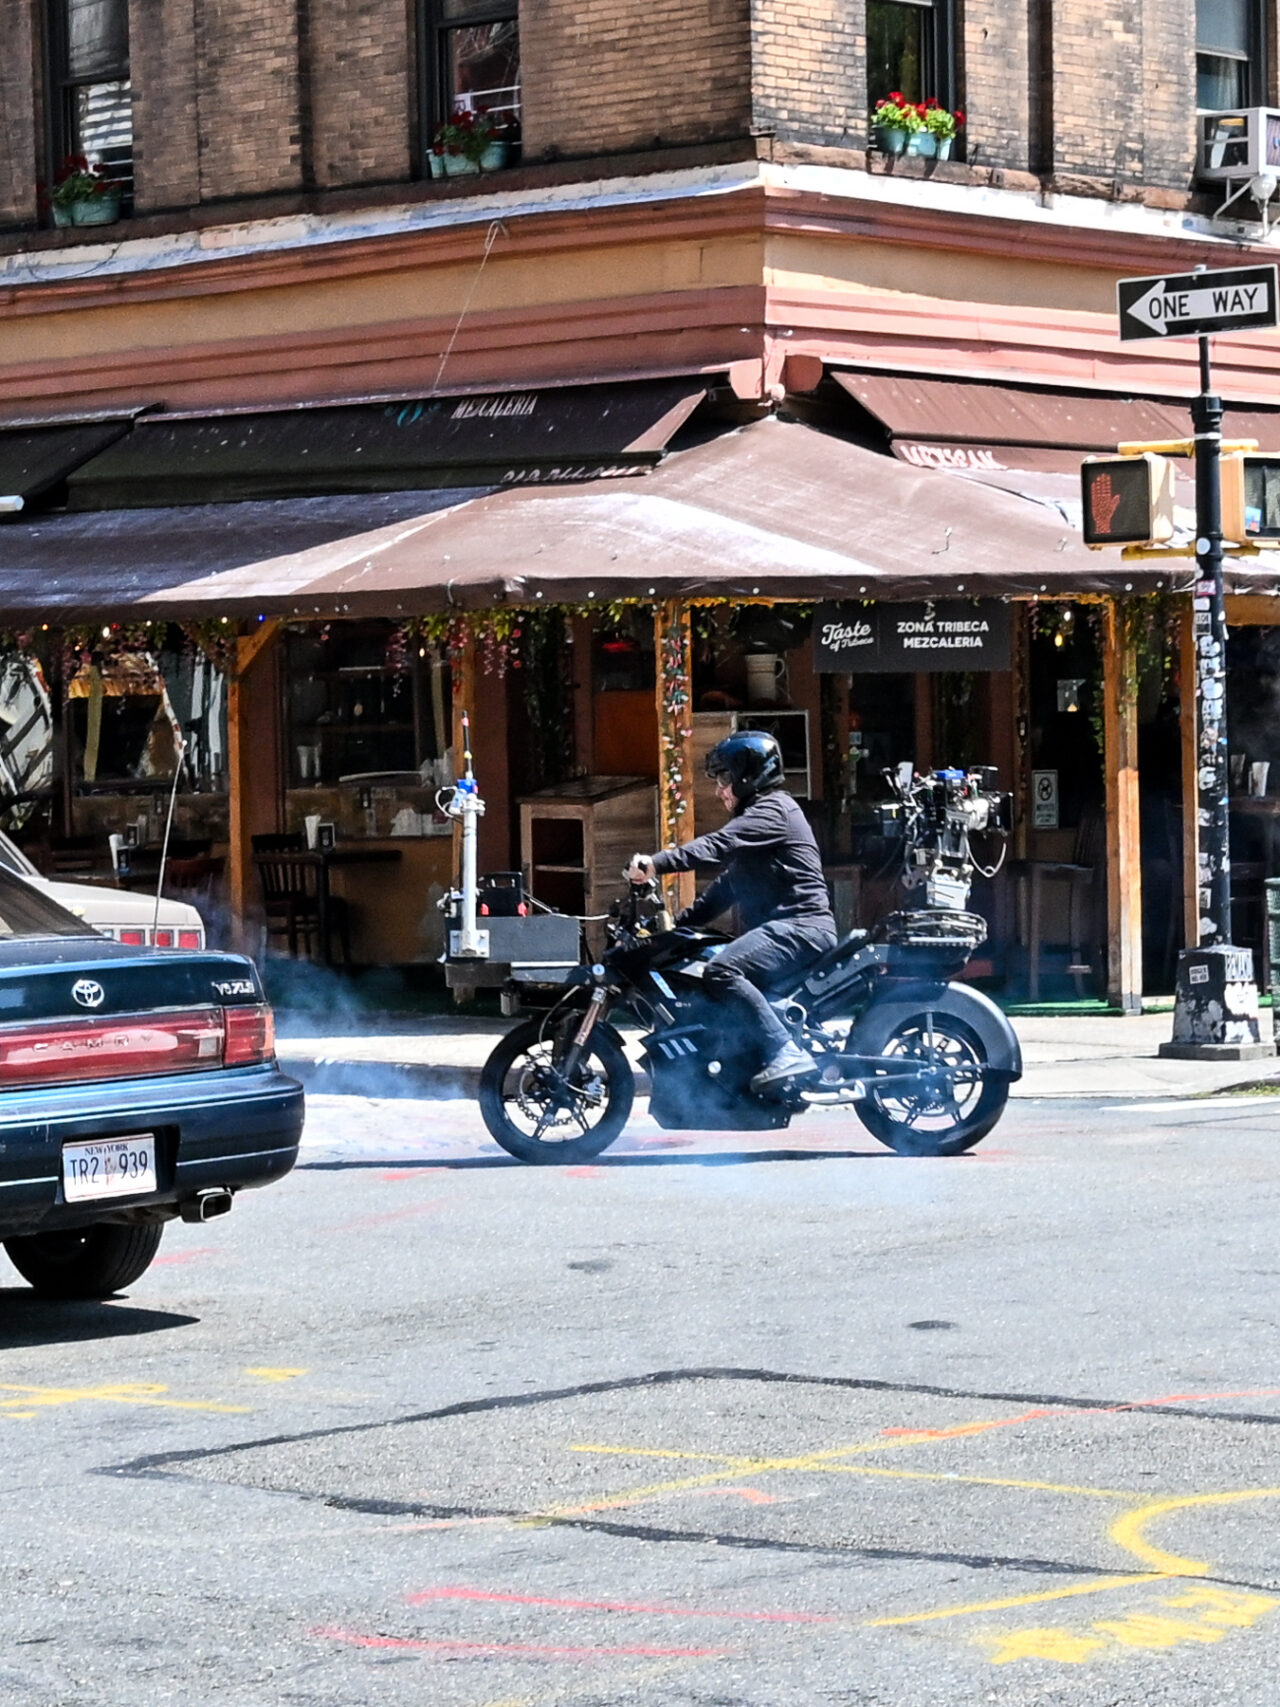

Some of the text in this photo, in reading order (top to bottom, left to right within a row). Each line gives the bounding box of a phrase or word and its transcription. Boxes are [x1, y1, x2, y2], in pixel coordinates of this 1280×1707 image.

[1149, 287, 1258, 319] ONE WAY
[821, 620, 872, 646] Taste
[936, 621, 989, 632] TRIBECA
[829, 640, 840, 652] of
[903, 636, 983, 649] MEZCALERIA
[84, 1142, 129, 1156] NEW YORK
[69, 1150, 148, 1186] TR2 939
